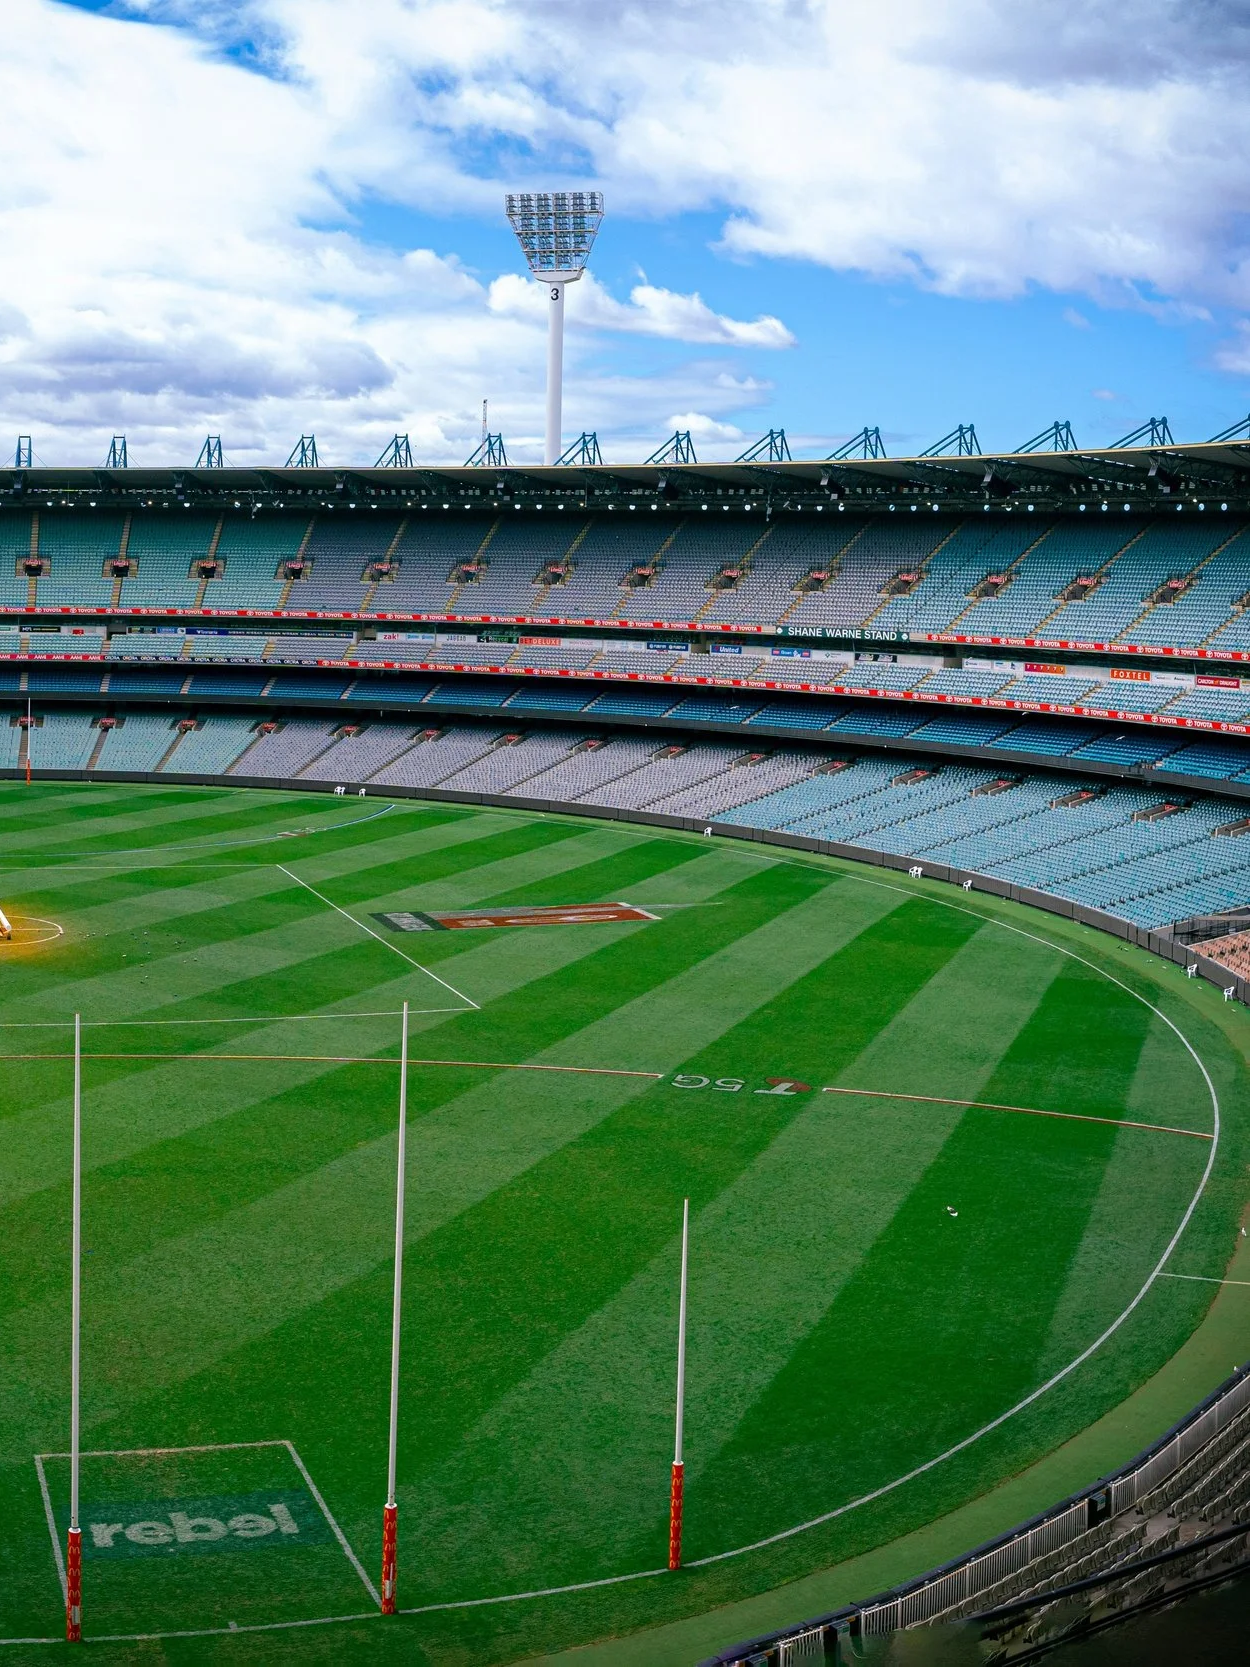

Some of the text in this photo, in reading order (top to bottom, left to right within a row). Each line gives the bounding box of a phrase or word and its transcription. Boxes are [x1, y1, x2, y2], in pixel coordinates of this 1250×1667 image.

[550, 288, 559, 300] 3
[788, 626, 897, 641] SHANE WARNE STAND
[1114, 671, 1148, 680] FOXTEL
[90, 1504, 298, 1548] rebel
